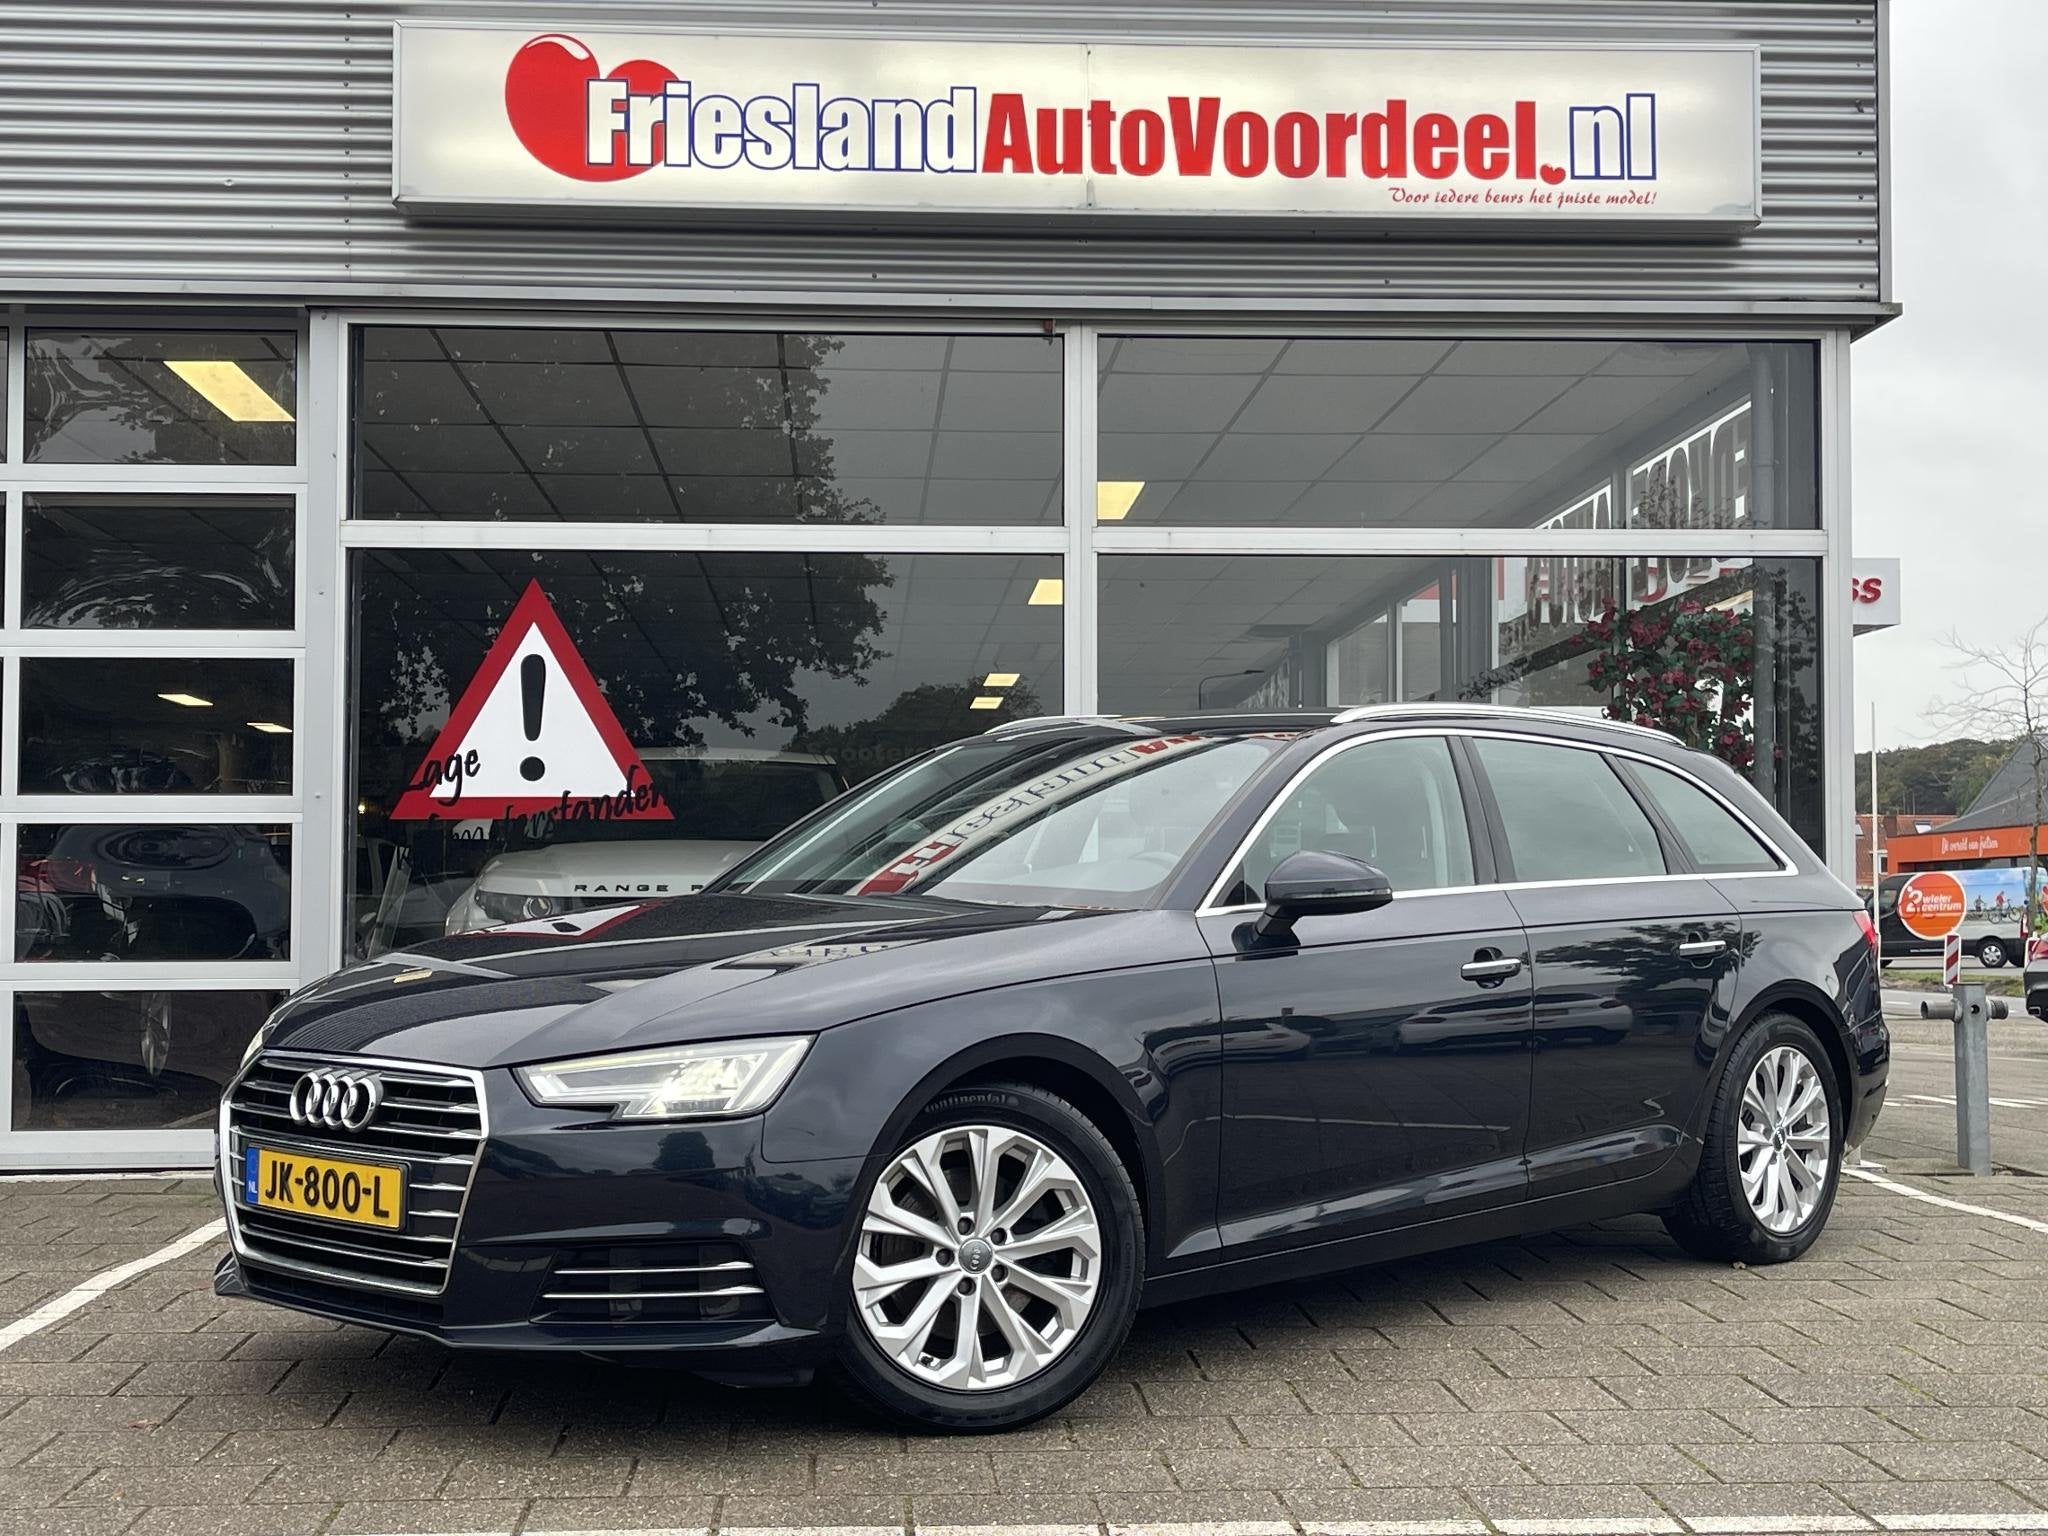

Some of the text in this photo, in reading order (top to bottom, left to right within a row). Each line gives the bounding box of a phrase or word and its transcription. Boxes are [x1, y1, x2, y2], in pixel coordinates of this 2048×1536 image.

[1388, 187, 1657, 208] Voor iedere beurs het juiste model!
[574, 884, 669, 892] RANGE
[265, 1160, 389, 1218] JK-800-L
